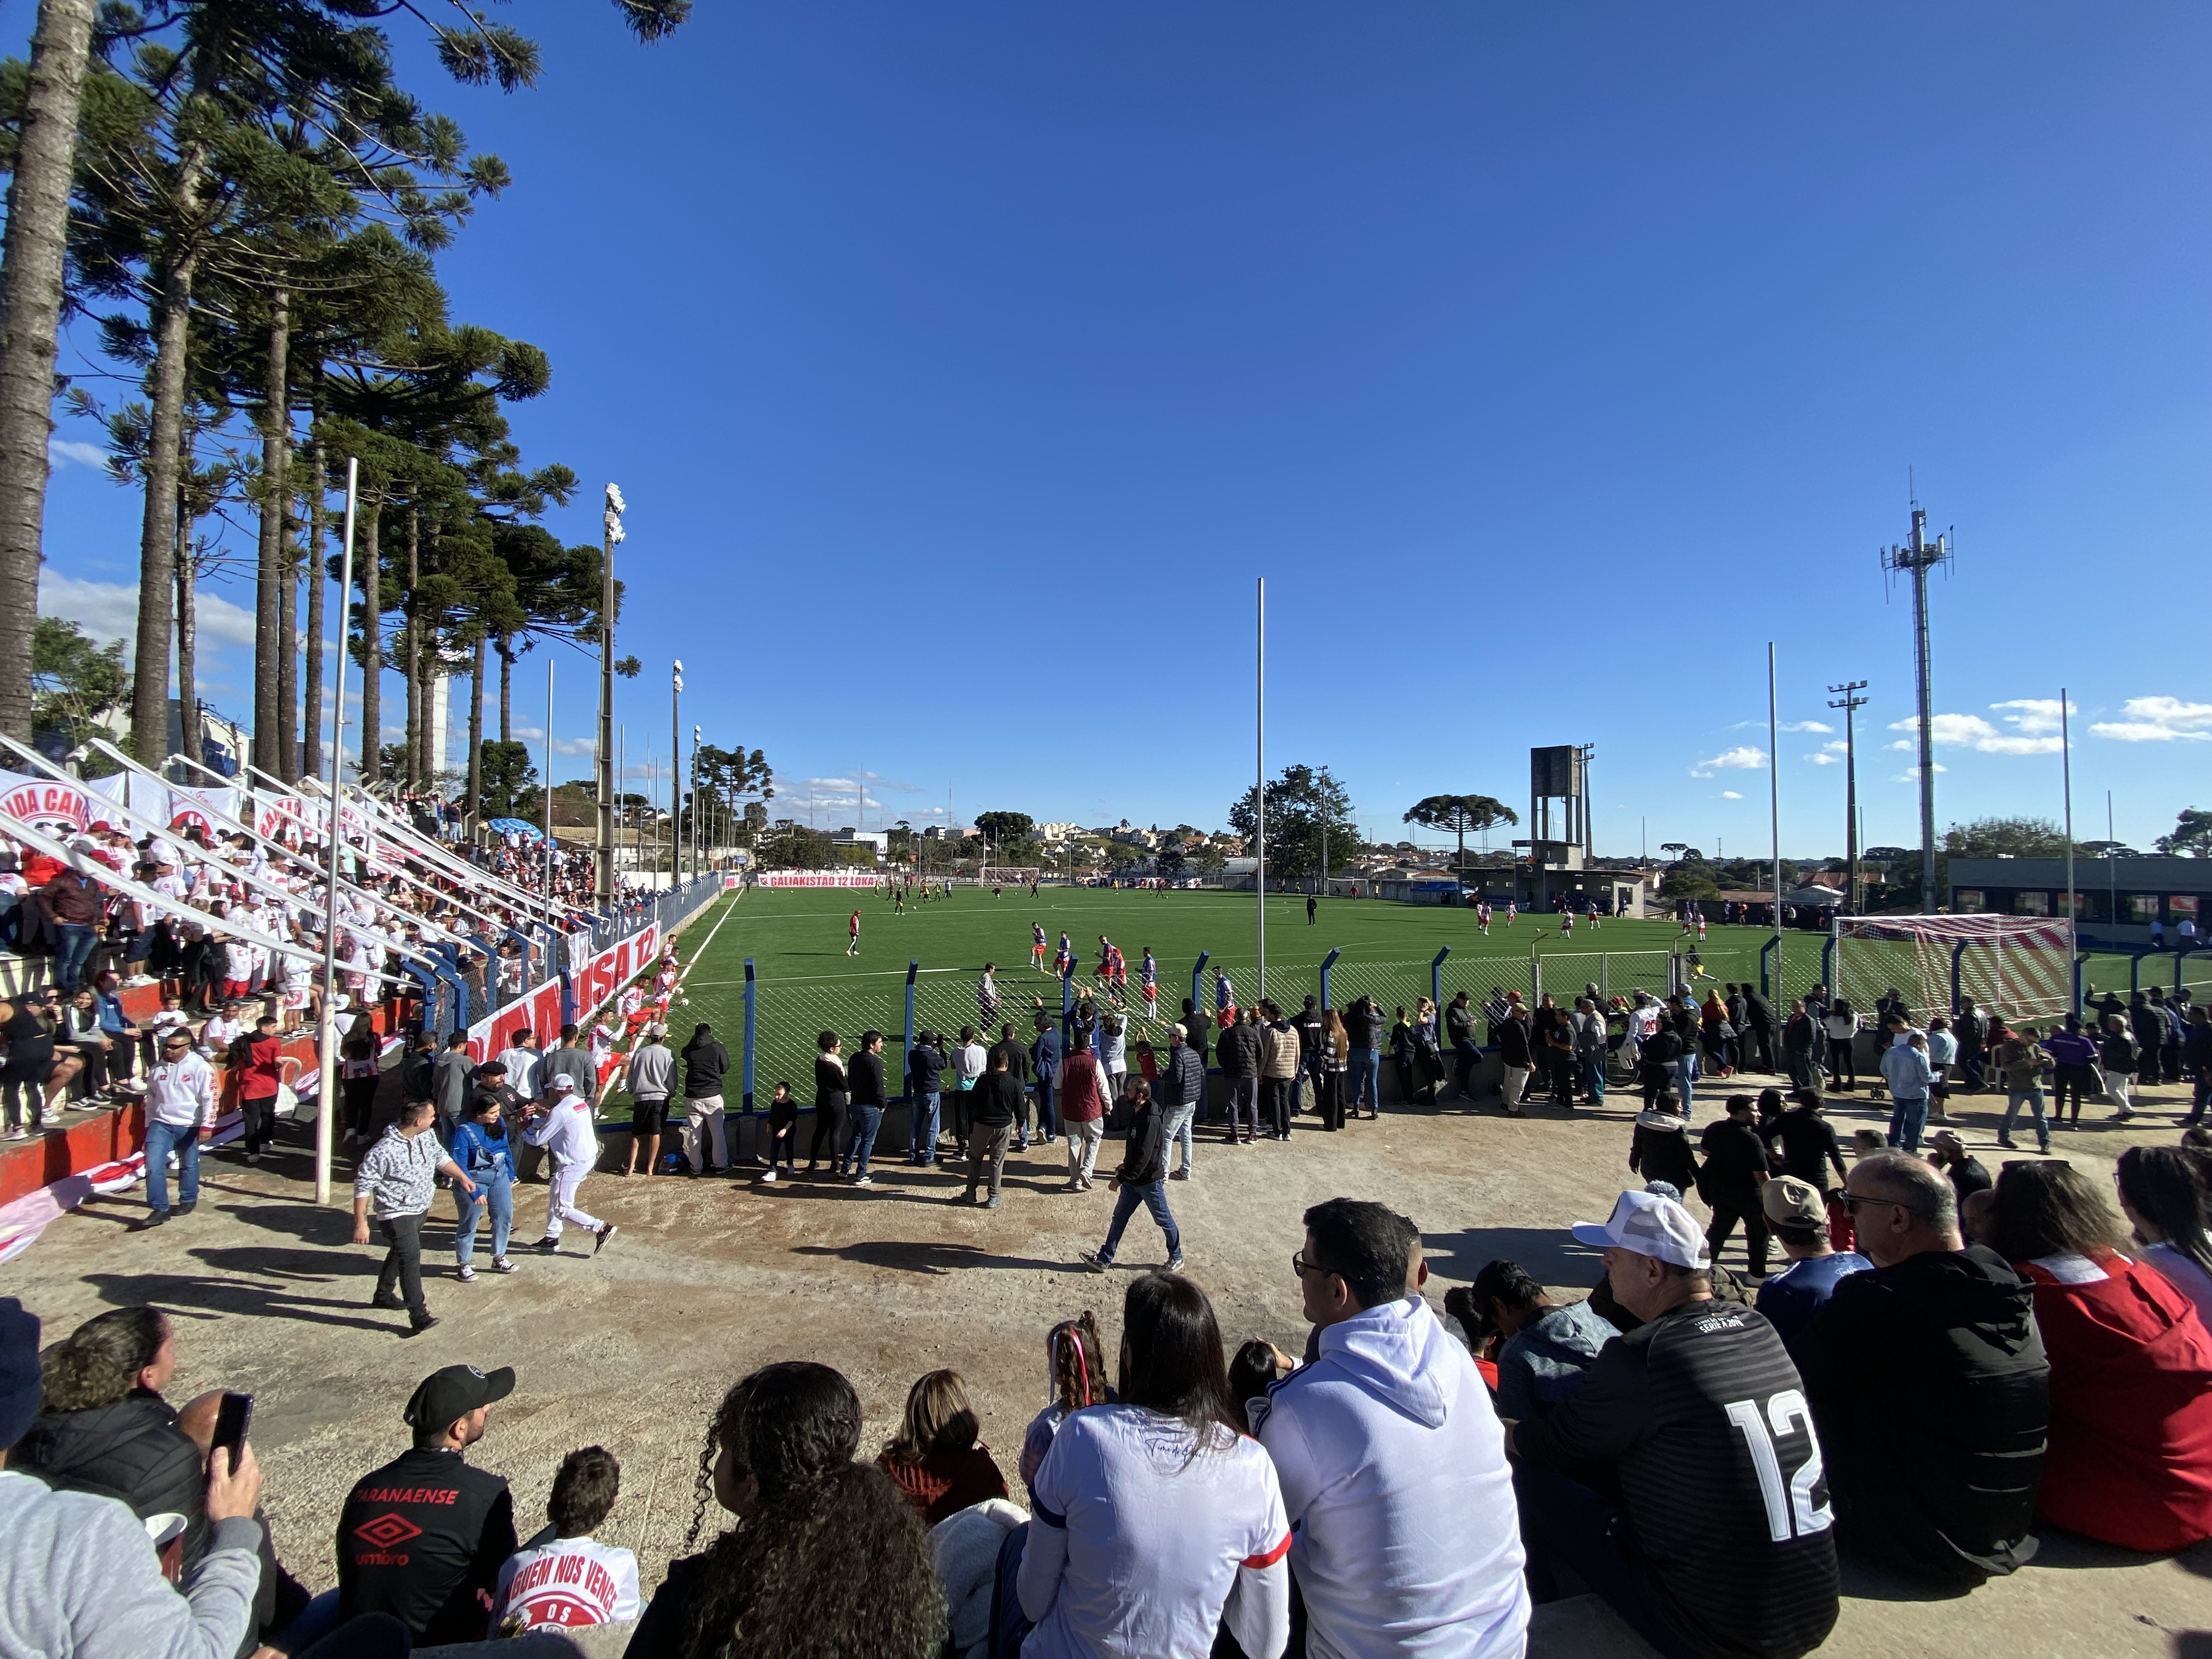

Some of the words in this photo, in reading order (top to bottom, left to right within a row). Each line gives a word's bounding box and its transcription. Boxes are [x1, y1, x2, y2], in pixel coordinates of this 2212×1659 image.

[838, 877, 848, 885] 12
[850, 877, 873, 885] LOKA
[635, 927, 655, 971] 12
[1723, 1389, 1835, 1542] 12
[354, 1488, 460, 1505] PARANAENSE
[356, 1549, 409, 1567] umbro
[552, 1555, 585, 1584] NOS
